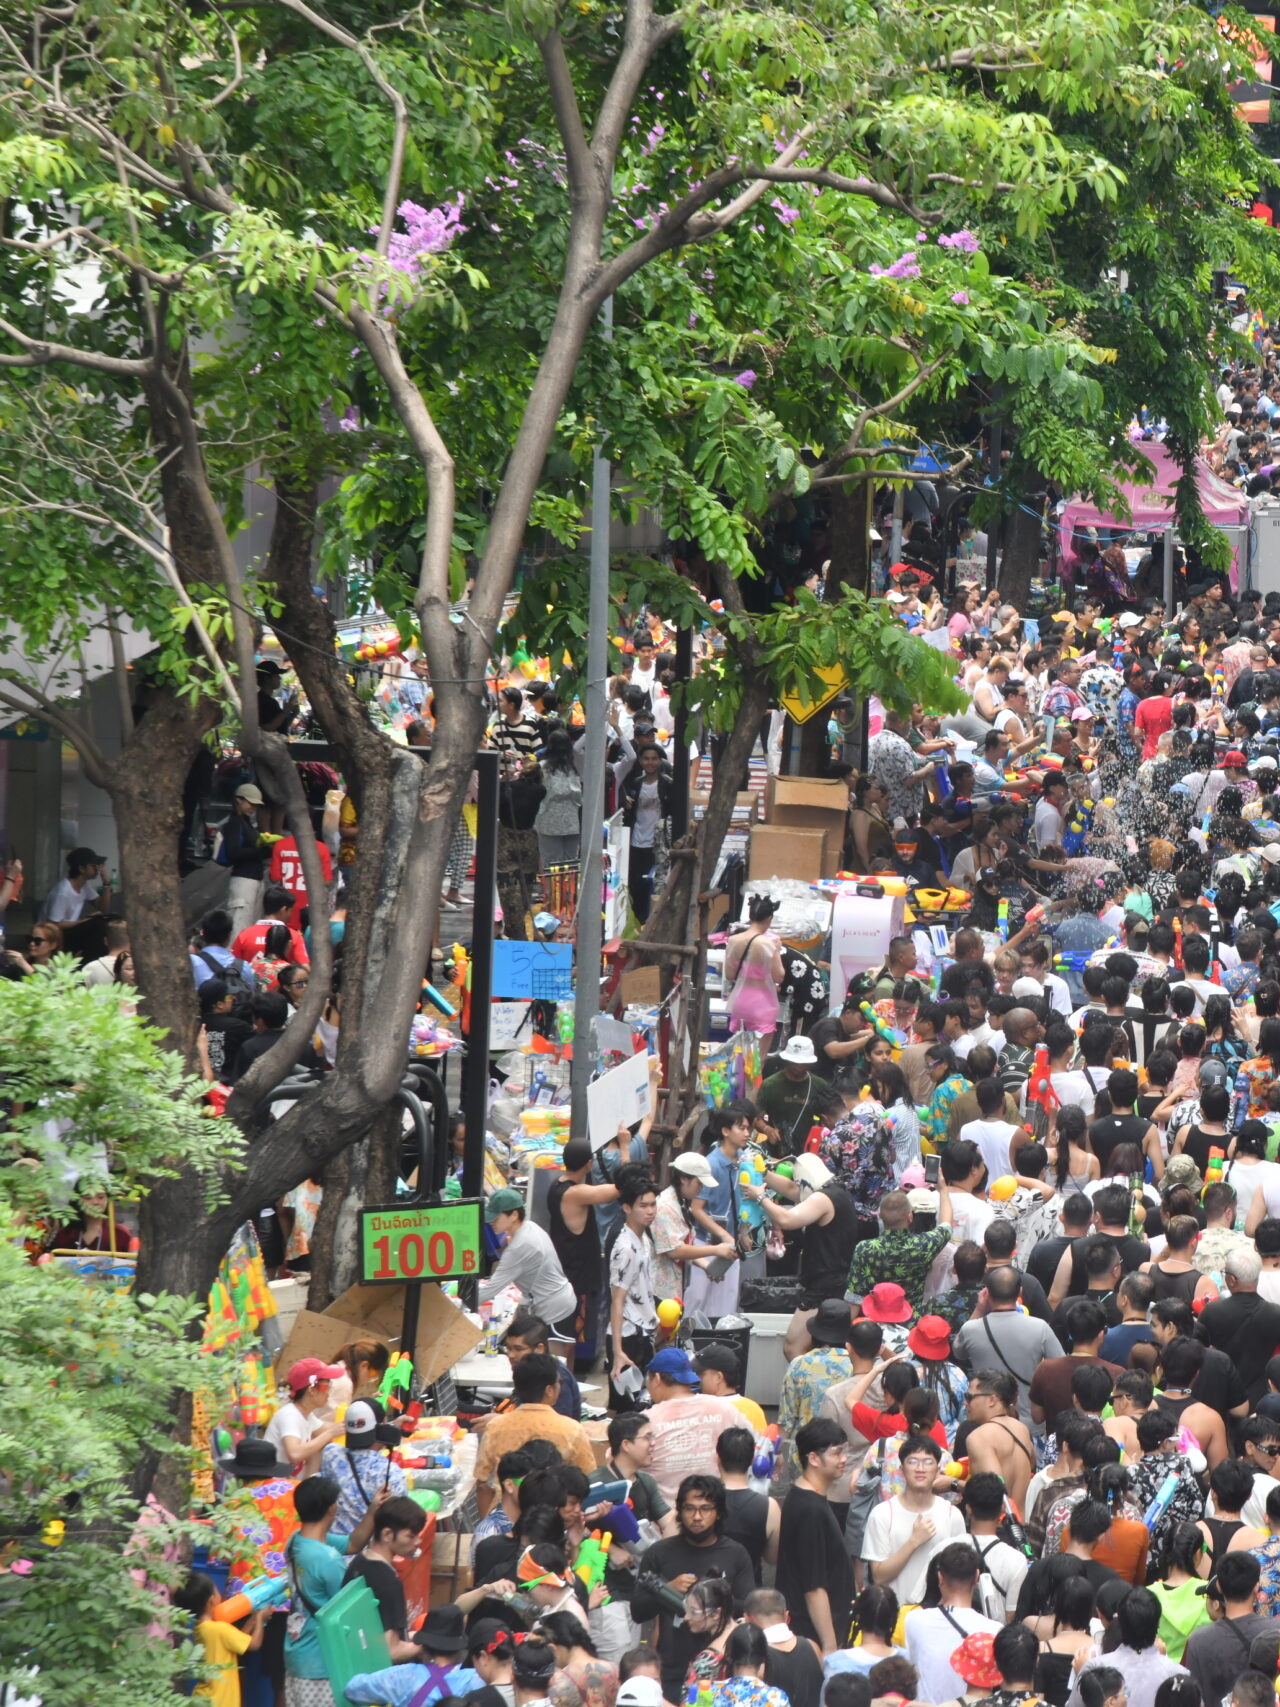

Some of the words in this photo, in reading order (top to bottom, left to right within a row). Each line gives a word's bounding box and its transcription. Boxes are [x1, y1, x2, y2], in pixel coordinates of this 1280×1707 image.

[371, 1211, 430, 1231] ปืนฉีดน้ำ
[373, 1230, 454, 1279] 100
[656, 1414, 722, 1431] TIMBERLAND
